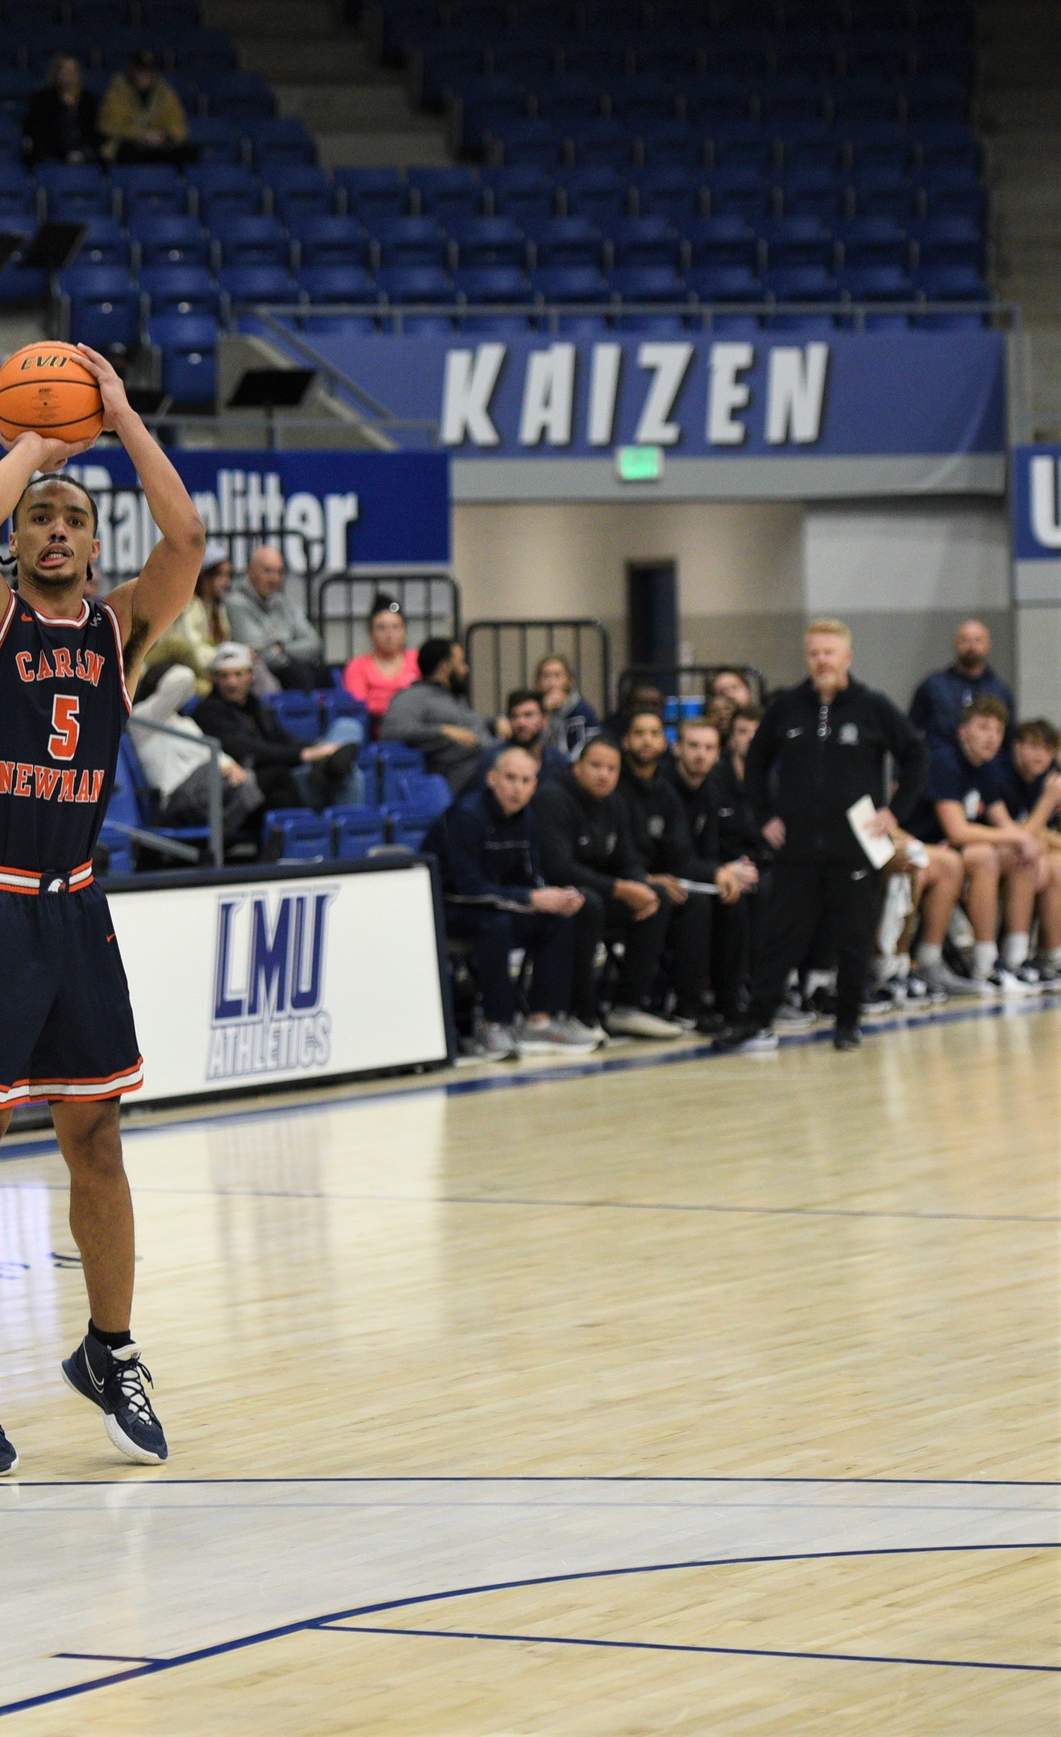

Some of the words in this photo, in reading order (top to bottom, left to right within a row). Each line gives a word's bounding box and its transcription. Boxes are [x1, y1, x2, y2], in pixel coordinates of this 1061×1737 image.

[440, 341, 831, 447] KAIZEN
[15, 647, 104, 687] CARSON
[48, 693, 80, 761] 5
[212, 885, 341, 1029] LMU
[205, 1010, 333, 1082] ATHLETICS
